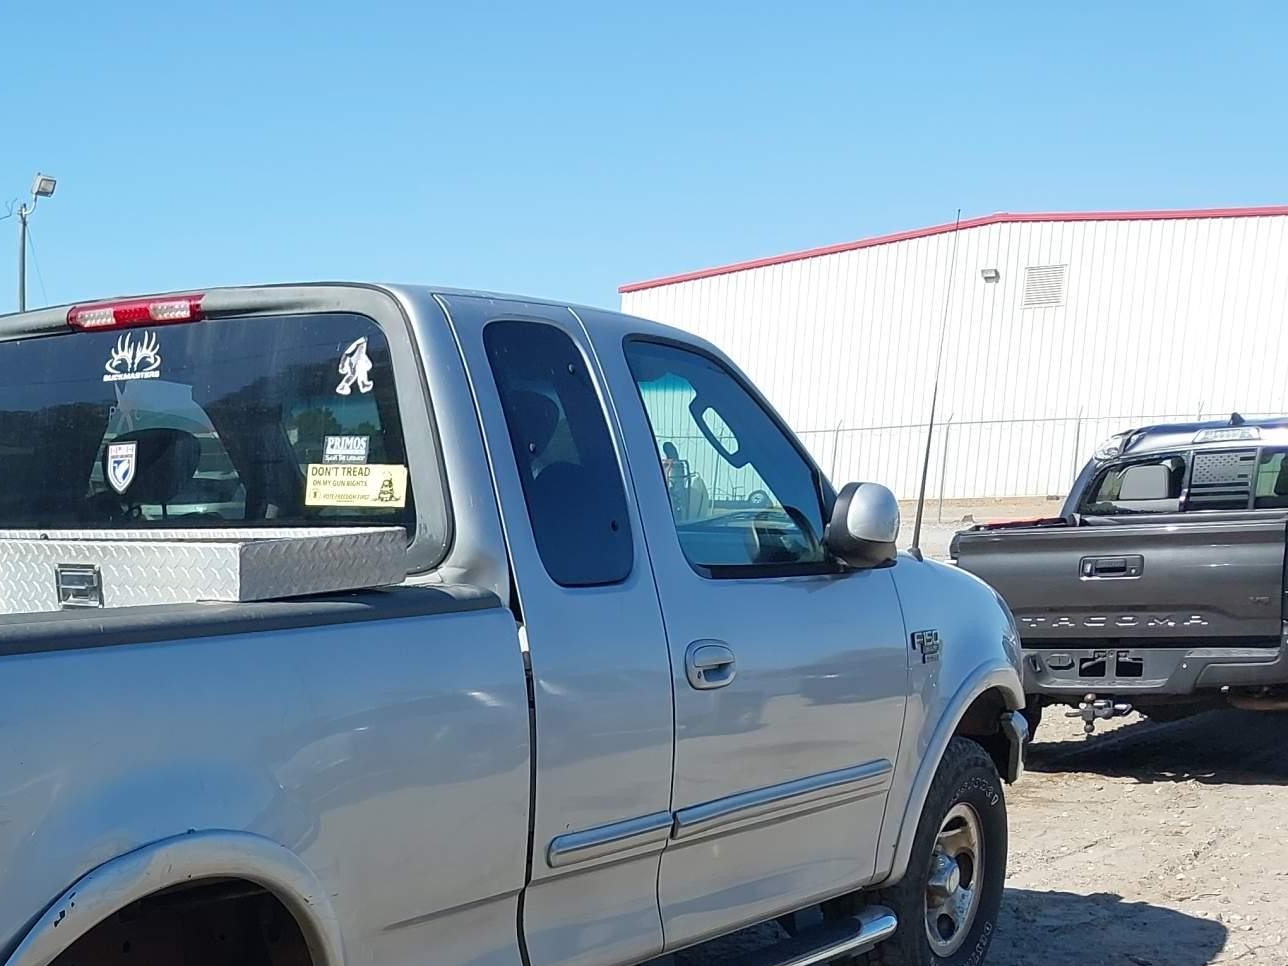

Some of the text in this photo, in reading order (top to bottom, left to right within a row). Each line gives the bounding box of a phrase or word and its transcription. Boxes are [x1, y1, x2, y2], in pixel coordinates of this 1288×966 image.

[327, 437, 367, 450] PRIMOS
[312, 466, 370, 476] DON'T TREAD
[1022, 615, 1208, 627] TACOMA
